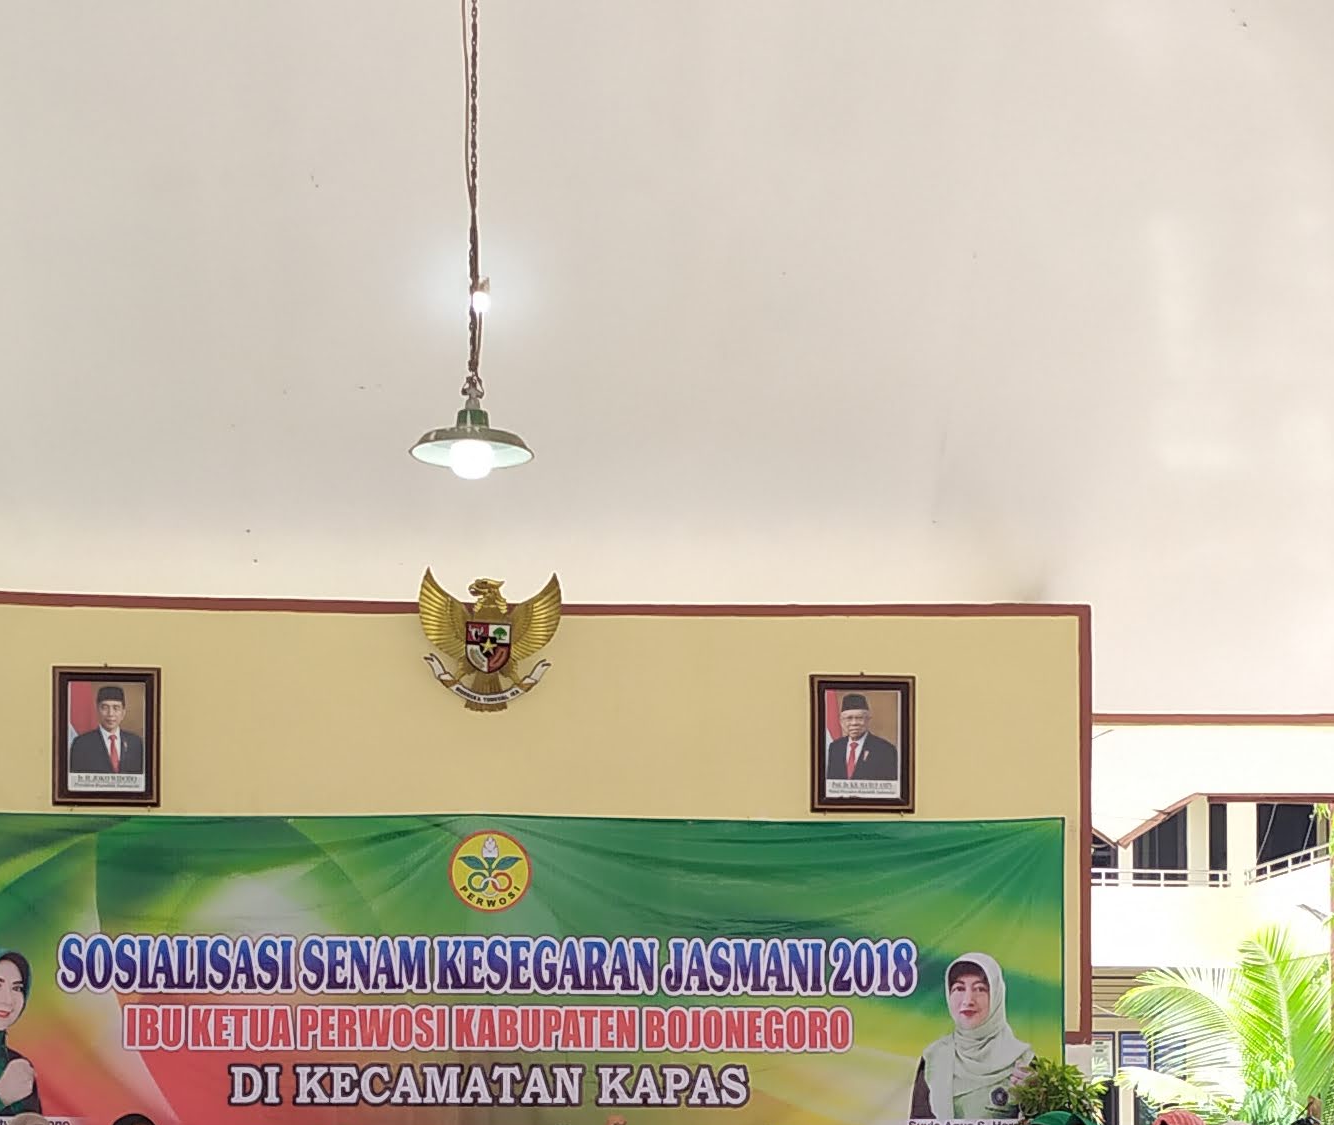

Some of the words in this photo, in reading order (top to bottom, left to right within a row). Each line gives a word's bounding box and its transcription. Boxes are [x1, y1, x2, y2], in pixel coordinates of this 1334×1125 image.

[459, 885, 521, 908] PERWOSI
[60, 937, 293, 991] SOSIALISASI
[303, 938, 428, 991] SENAM
[436, 938, 656, 992] KESEGARAN
[666, 939, 824, 992] JASMANI
[832, 940, 916, 993] 2018
[126, 1007, 183, 1048] IBU
[192, 1008, 291, 1048] KETUA
[300, 1008, 447, 1048] PERWOSI
[455, 1009, 638, 1049] KABUPATEN
[645, 1009, 851, 1050] BOJONEGORO
[229, 1065, 280, 1104] DI
[297, 1066, 583, 1105] KECAMATAN
[598, 1066, 750, 1105] KAPAS
